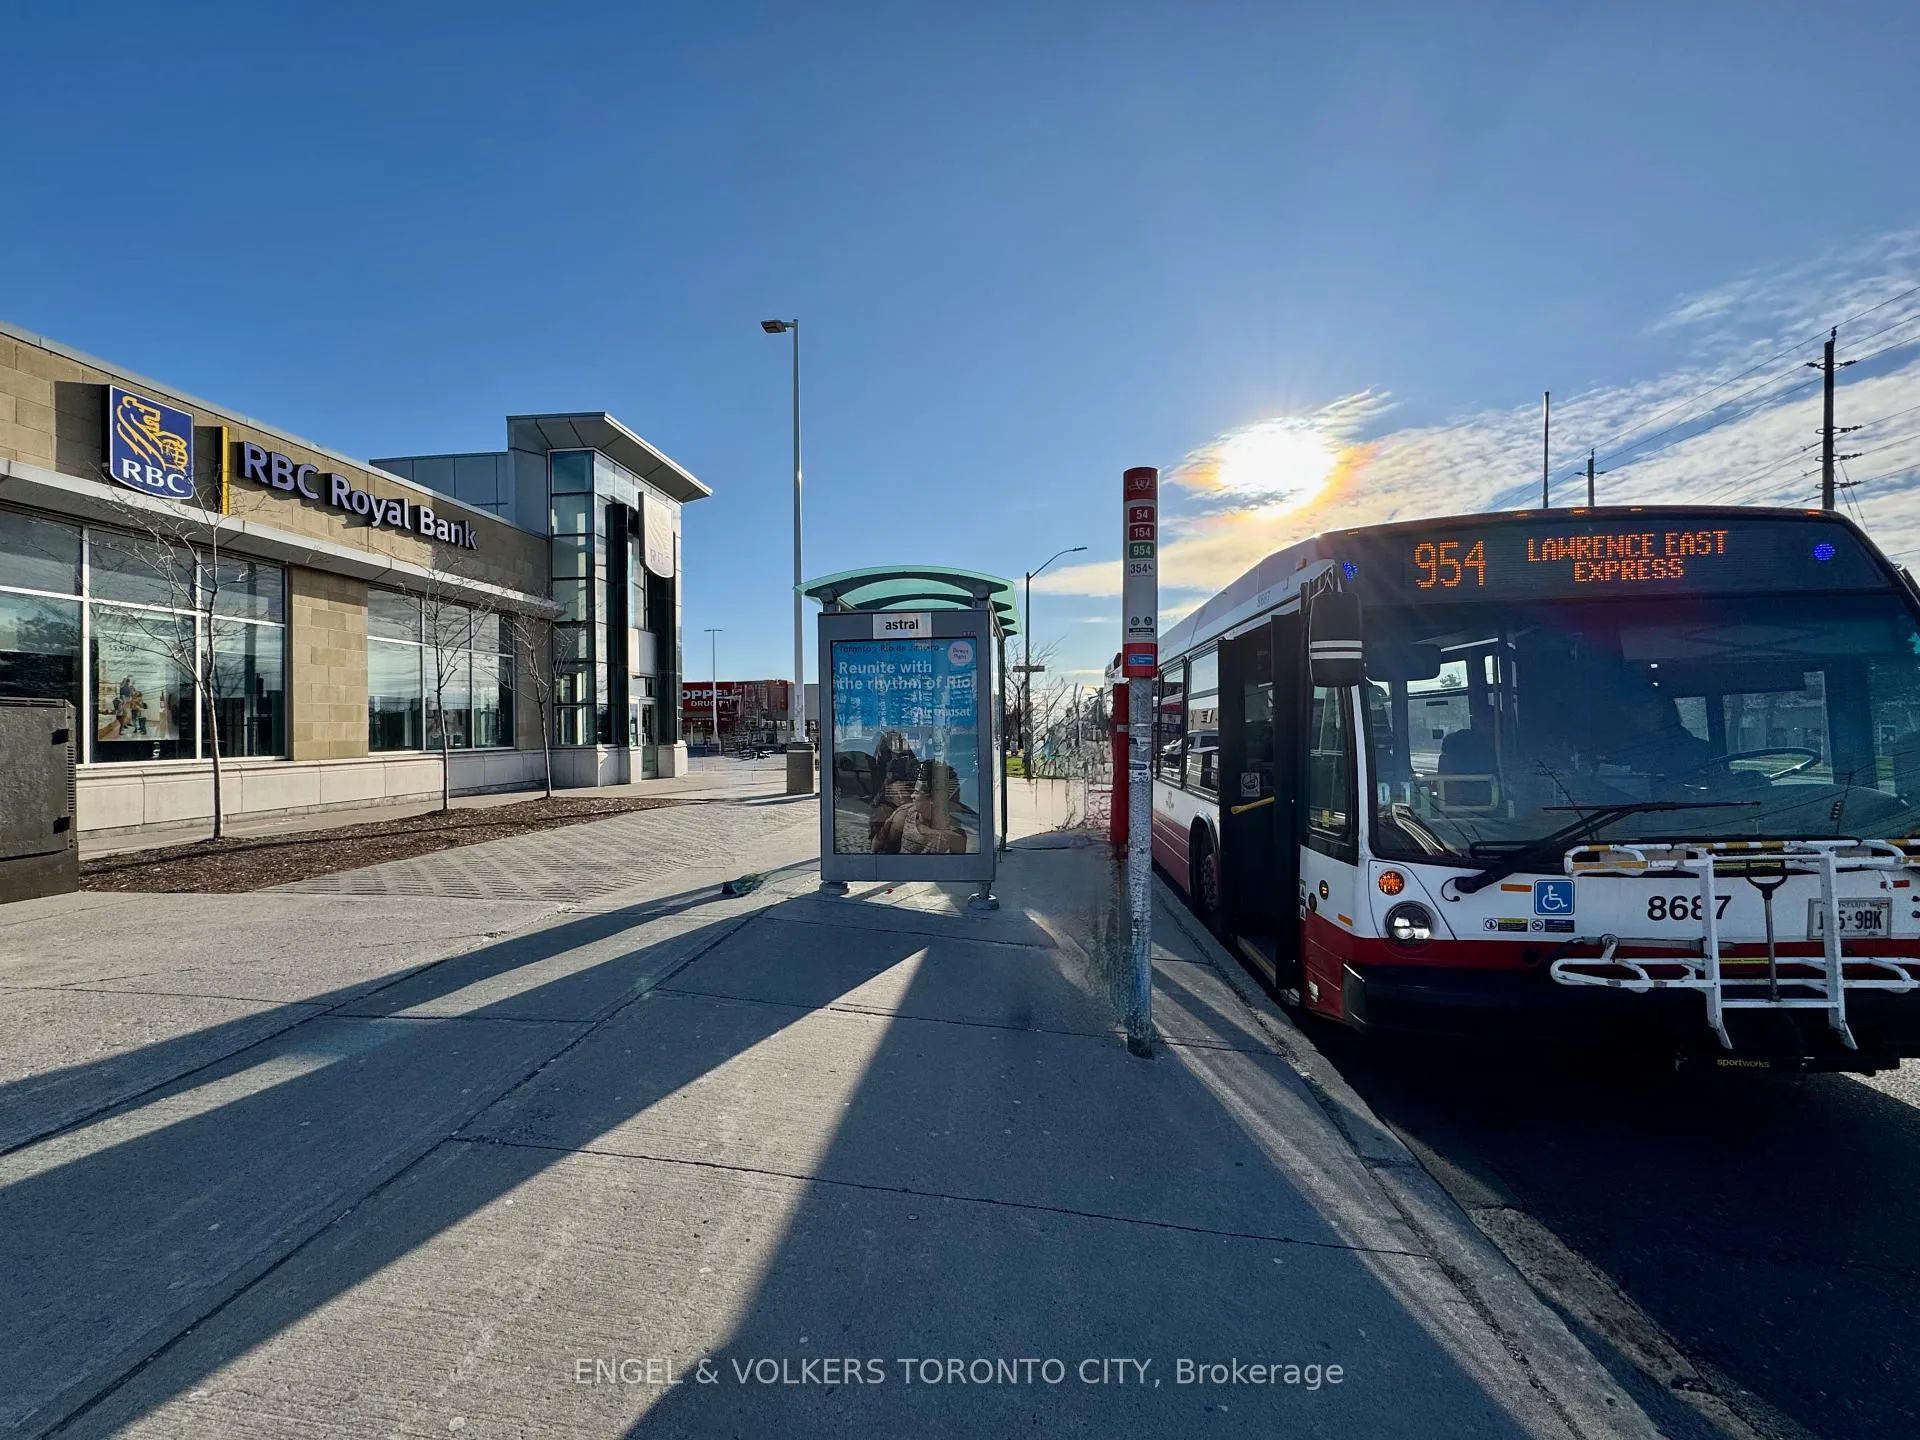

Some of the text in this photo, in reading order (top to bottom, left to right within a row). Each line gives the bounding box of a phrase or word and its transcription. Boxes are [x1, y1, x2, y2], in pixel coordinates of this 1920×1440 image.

[121, 457, 186, 494] RBC
[244, 441, 478, 550] RBC Royal Bank
[1136, 509, 1149, 519] 54
[1133, 527, 1151, 538] 154
[1133, 545, 1151, 556] 954
[1526, 529, 1729, 562] LAWRENCE EAST
[1129, 563, 1148, 574] 354
[1414, 540, 1487, 588] 954
[1573, 558, 1685, 583] EXPRESS
[885, 618, 919, 631] astral
[839, 660, 932, 674] Reunite with
[838, 677, 863, 690] the
[867, 675, 922, 693] rhythm
[927, 675, 942, 689] of
[1647, 895, 1732, 921] 8687
[1716, 1058, 1771, 1069] sportworks
